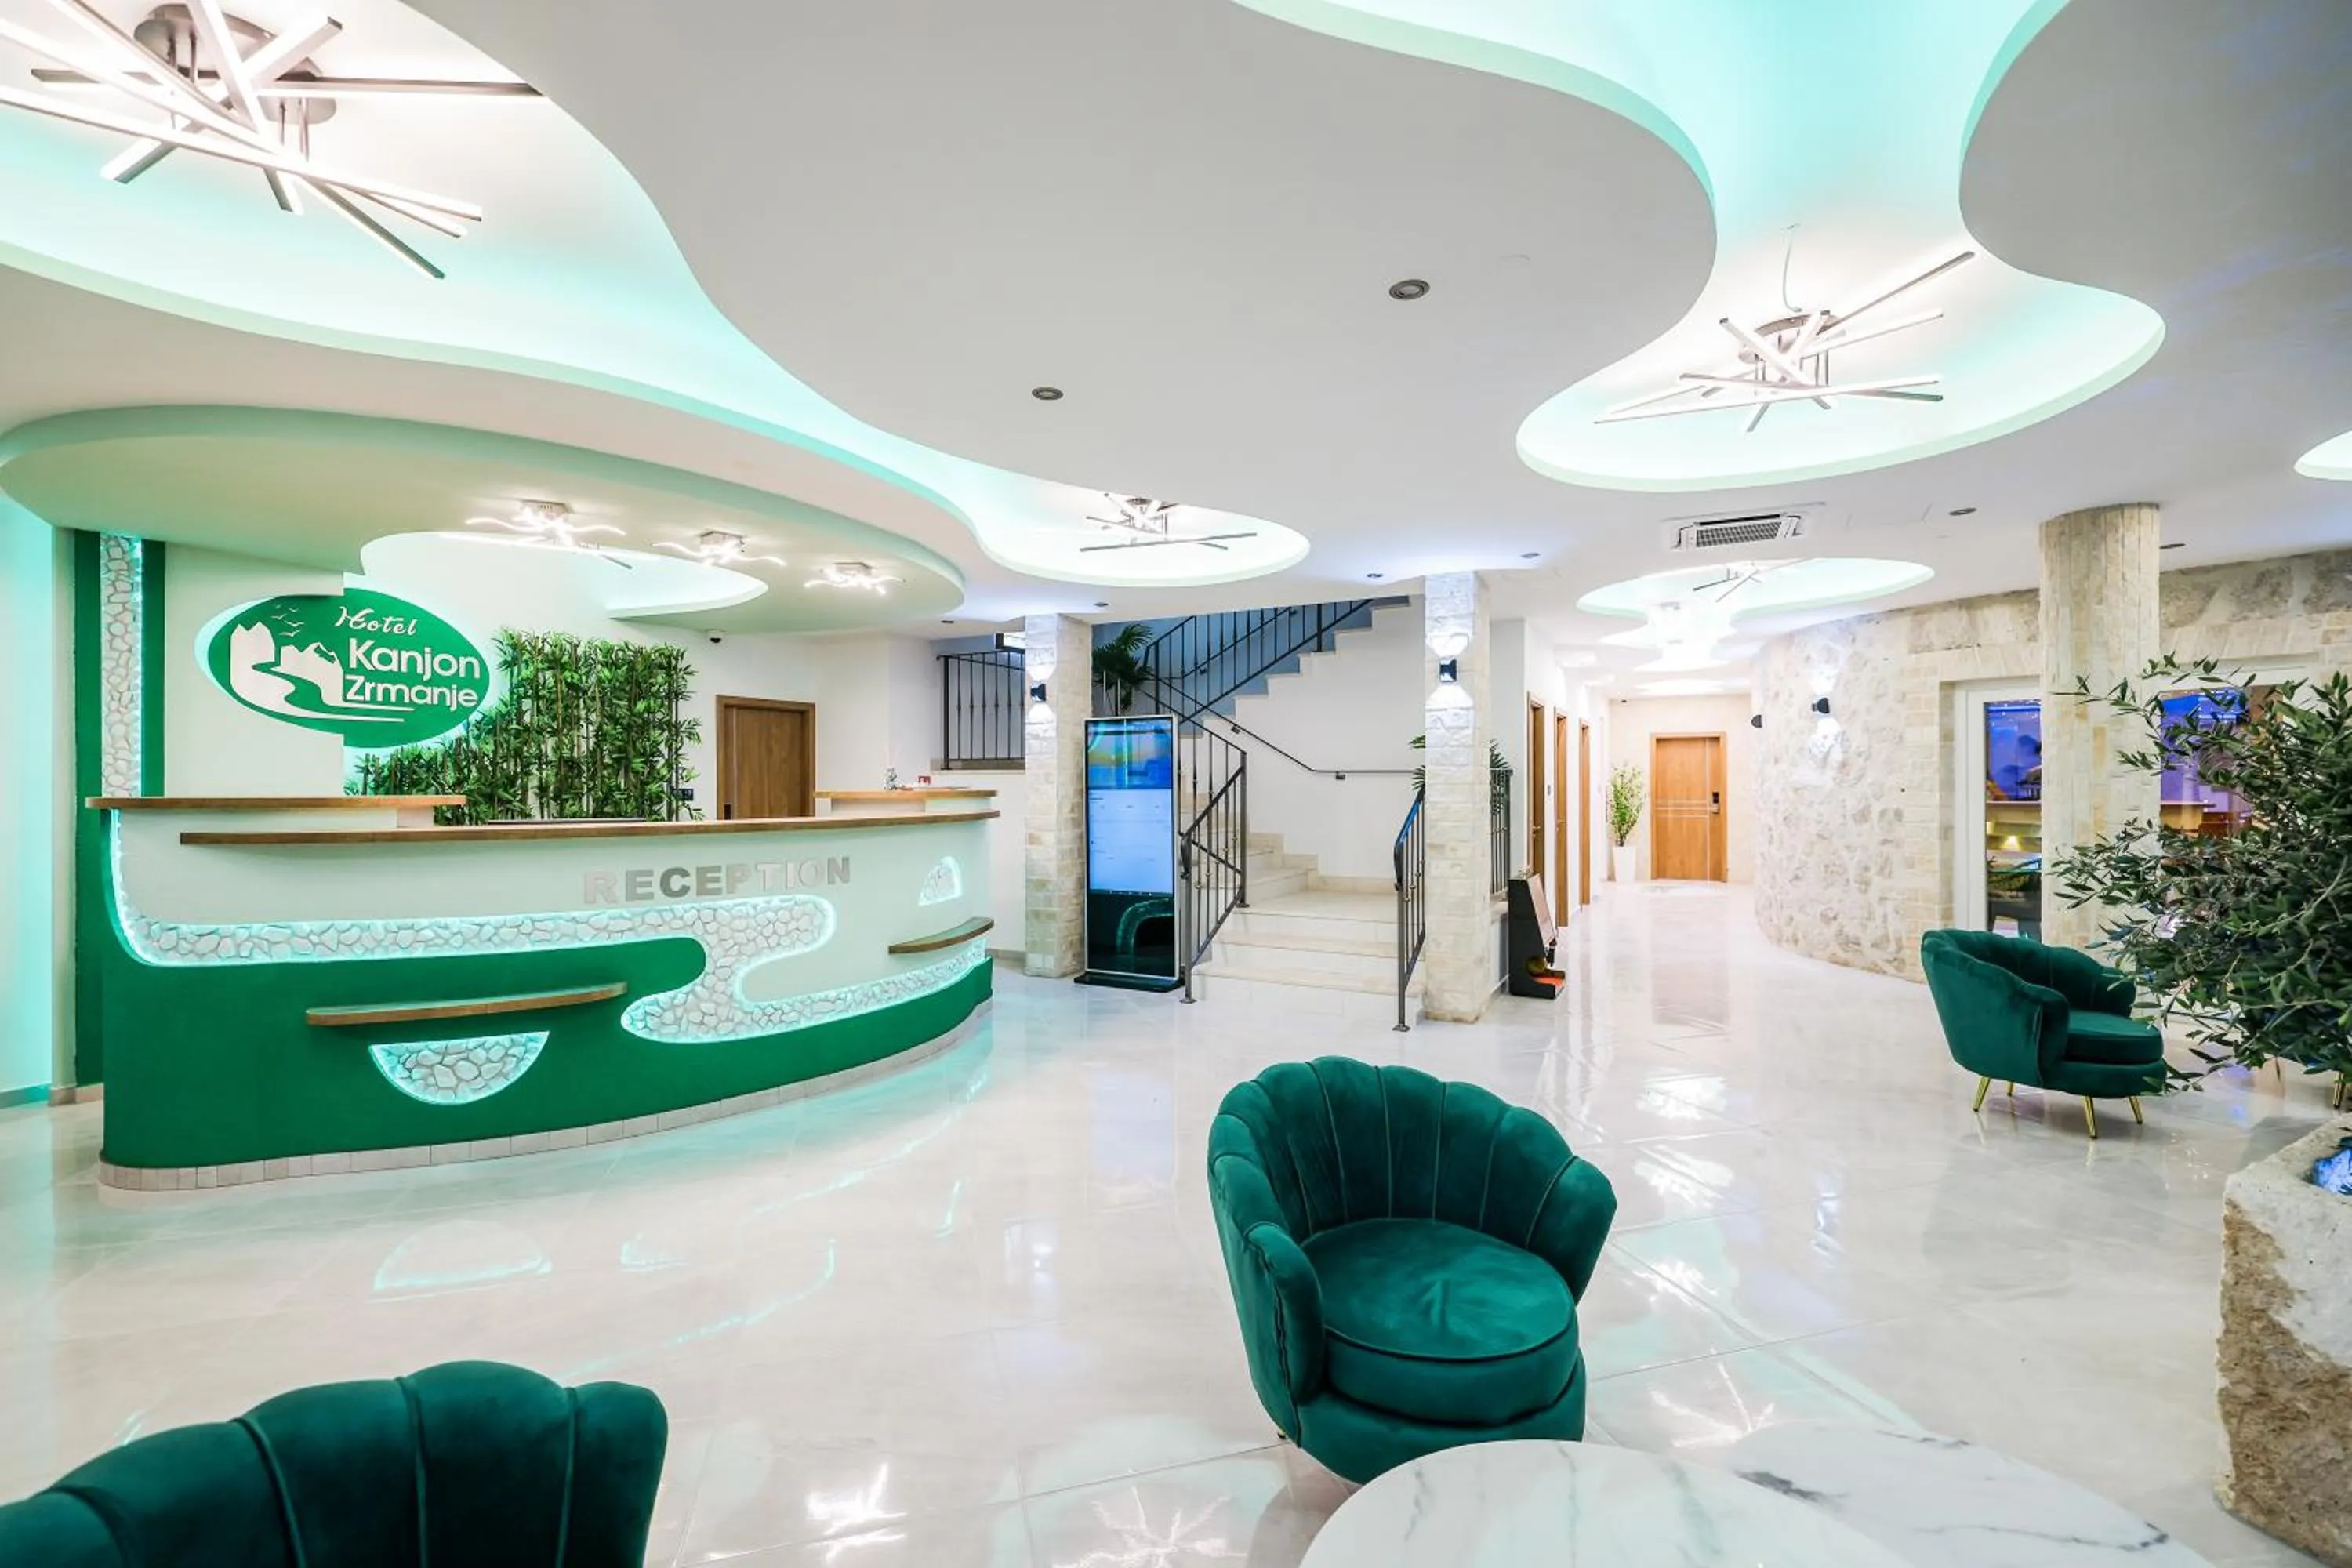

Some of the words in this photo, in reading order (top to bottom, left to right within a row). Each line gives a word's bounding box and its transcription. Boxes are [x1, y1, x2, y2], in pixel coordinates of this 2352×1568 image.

[335, 606, 417, 635] Hotel
[348, 637, 481, 680] Kanjon
[345, 674, 478, 710] Zrmanje
[584, 855, 851, 904] RECEPTION
